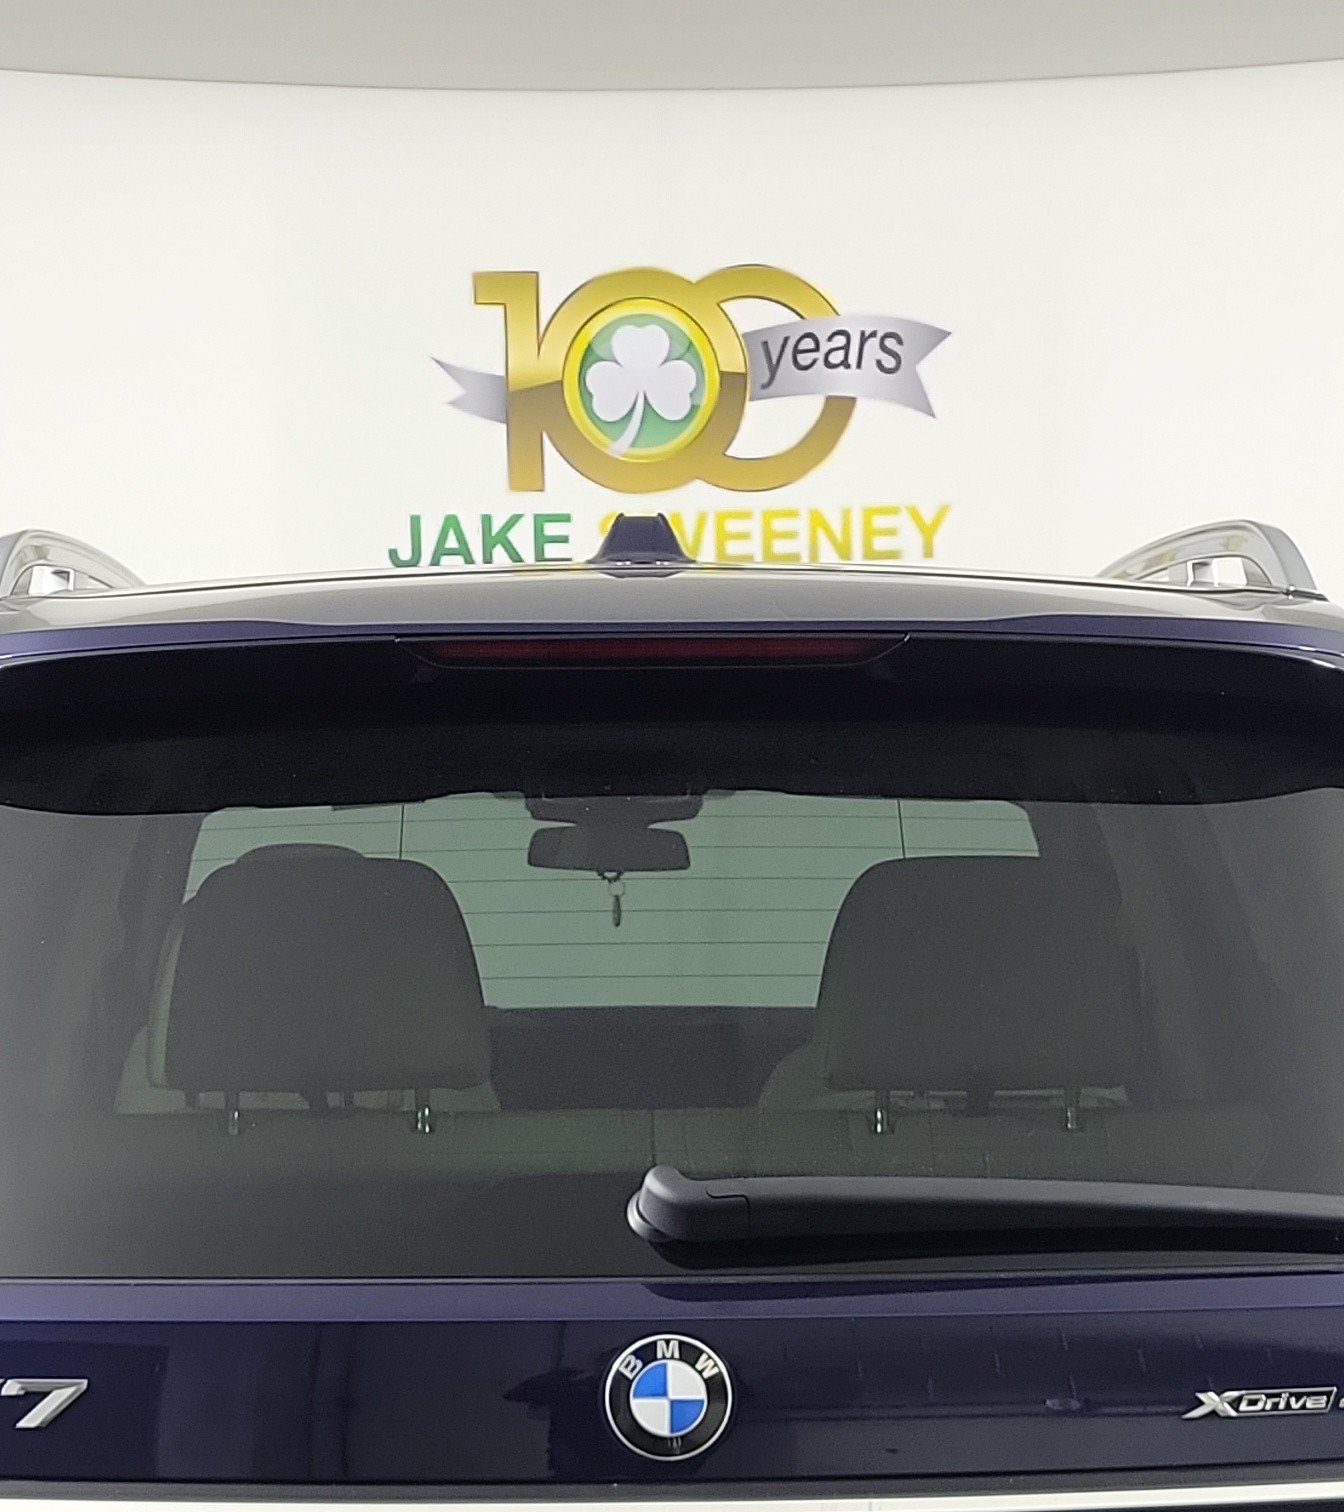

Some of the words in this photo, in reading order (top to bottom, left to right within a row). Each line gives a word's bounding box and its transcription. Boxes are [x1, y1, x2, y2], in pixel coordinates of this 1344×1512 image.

[472, 264, 857, 492] 100
[760, 328, 904, 391] years
[387, 513, 573, 567] JAKE
[618, 1339, 720, 1380] BMW
